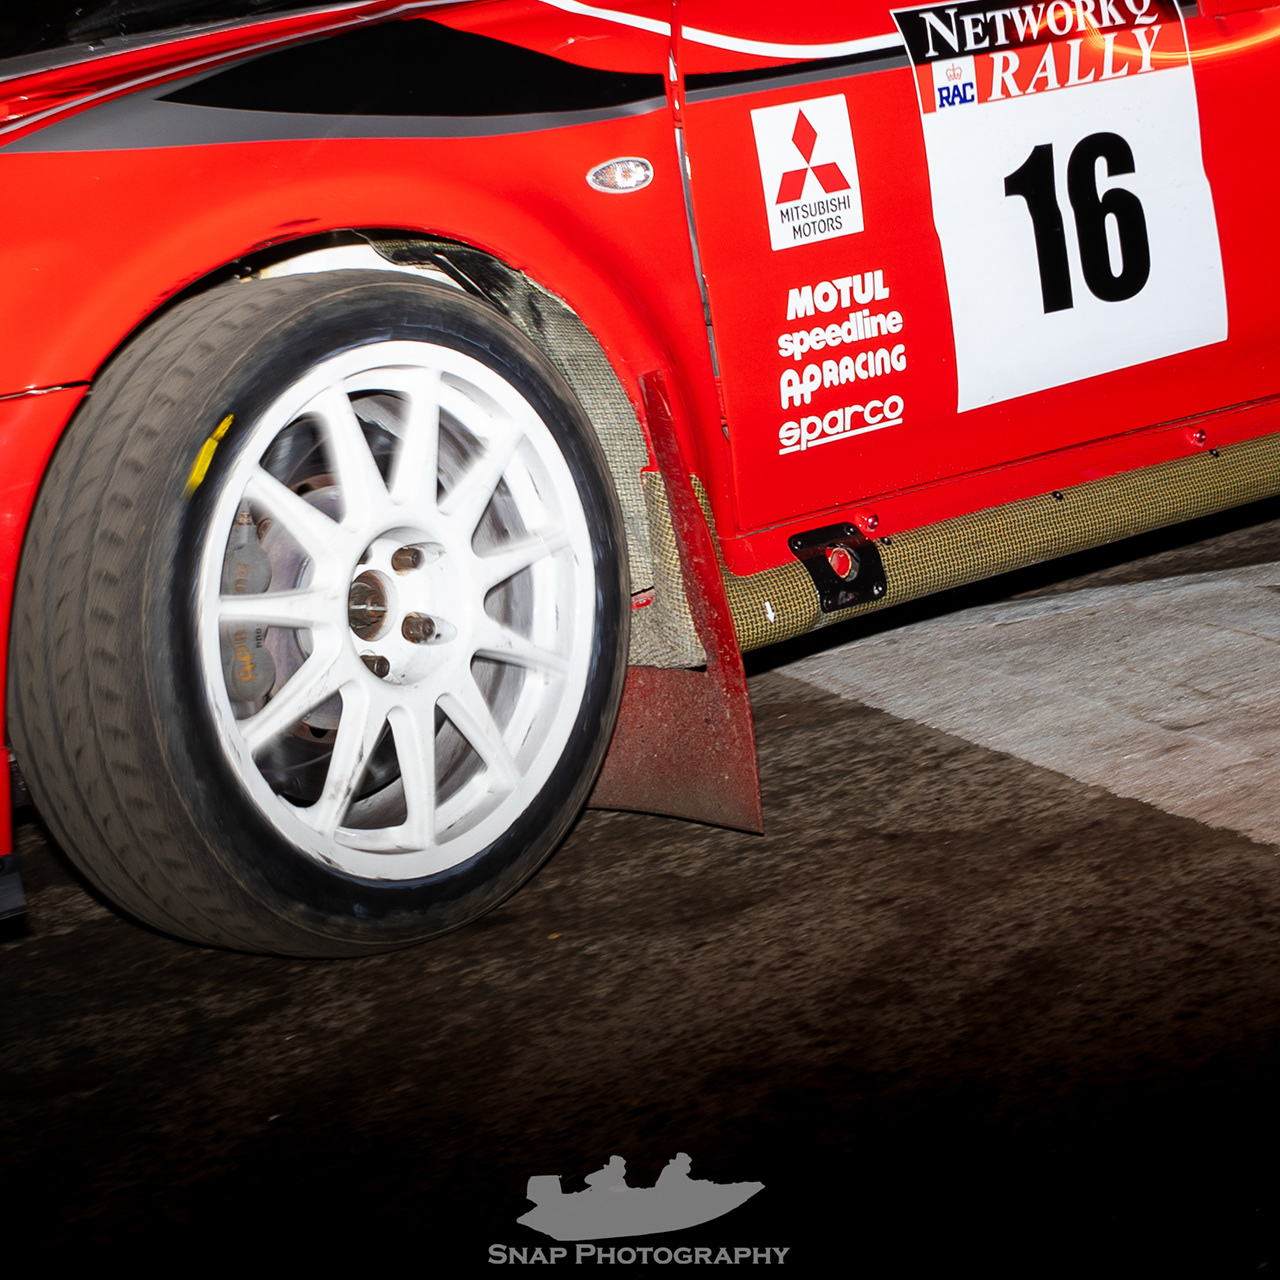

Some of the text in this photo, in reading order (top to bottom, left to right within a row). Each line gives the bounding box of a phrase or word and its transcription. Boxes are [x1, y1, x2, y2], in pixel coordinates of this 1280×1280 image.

[937, 25, 1162, 108] RAC RALLY
[780, 195, 851, 224] MITSUBISHI
[792, 215, 843, 240] MOTORS
[1004, 132, 1151, 315] 16
[786, 269, 890, 320] MOTUL
[778, 309, 903, 361] speedline
[779, 395, 904, 455] sparco
